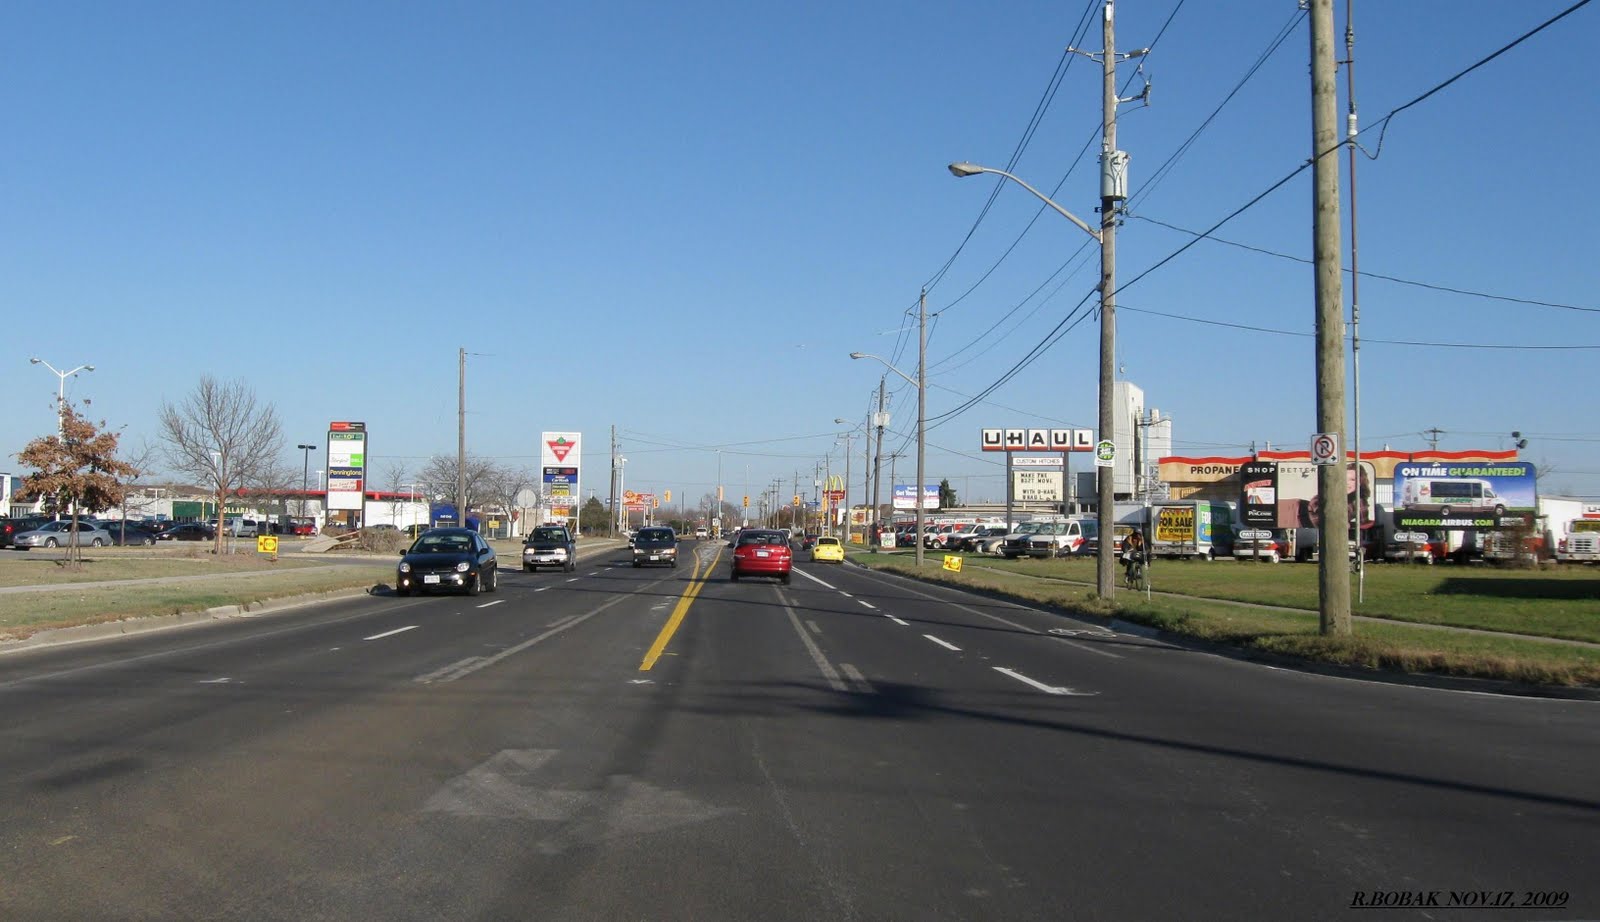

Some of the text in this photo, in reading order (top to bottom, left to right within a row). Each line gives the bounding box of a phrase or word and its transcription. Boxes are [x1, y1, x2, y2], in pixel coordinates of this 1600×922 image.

[330, 469, 362, 477] Penningtons
[1190, 466, 1240, 475] PROPANE
[1402, 468, 1526, 476] ON TIME GUARANTEED!
[1159, 517, 1192, 527] FOR SALE
